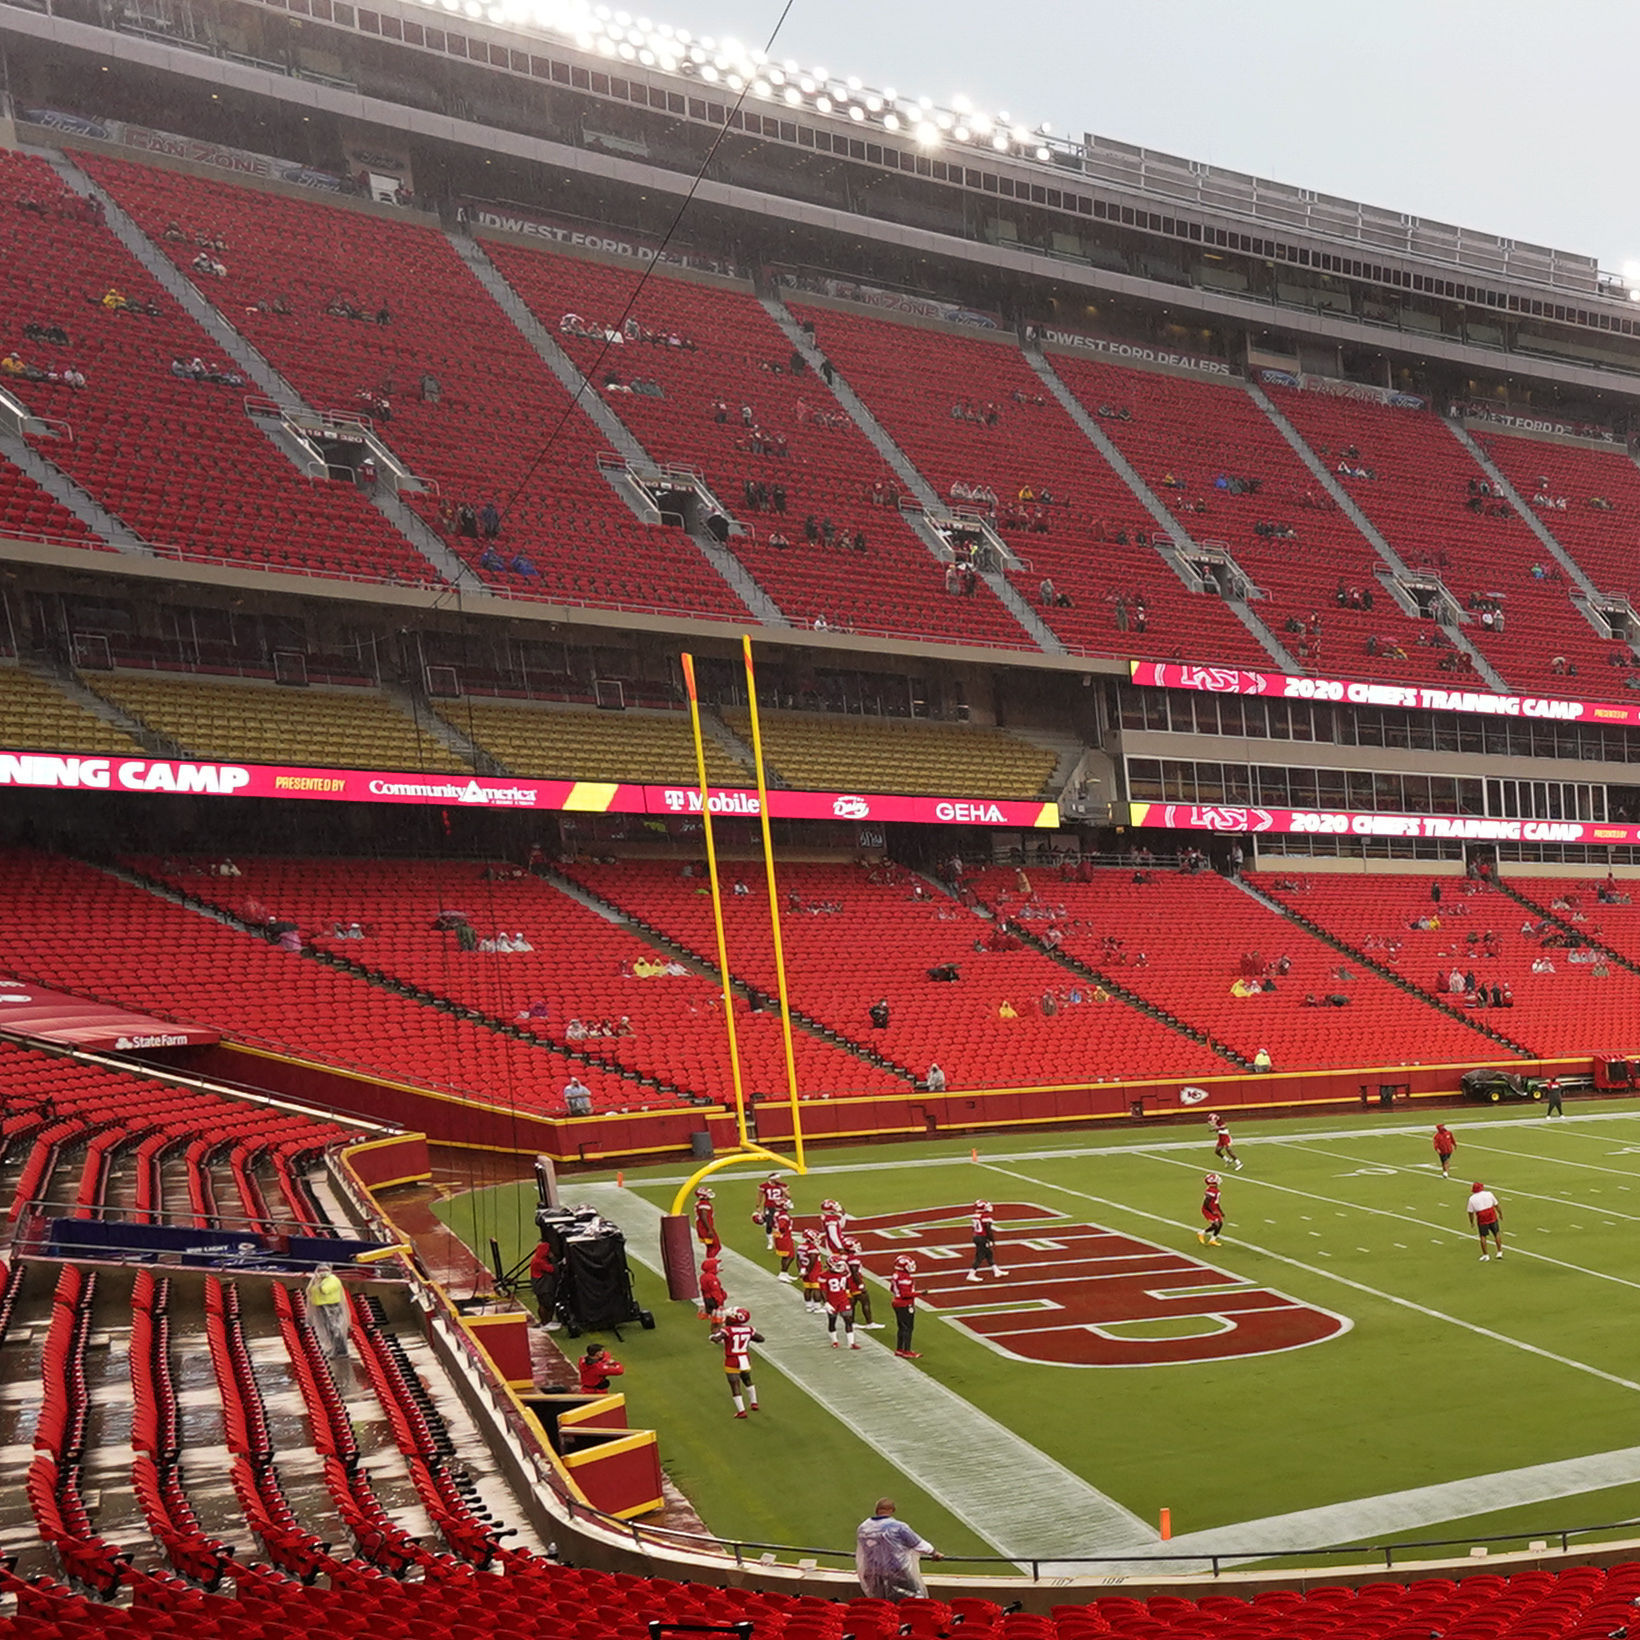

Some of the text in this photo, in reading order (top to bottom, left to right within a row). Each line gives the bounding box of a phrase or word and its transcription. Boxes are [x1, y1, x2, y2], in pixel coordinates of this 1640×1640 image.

[571, 232, 633, 255] FORD
[1110, 343, 1230, 375] FORD DEALERS
[1263, 371, 1298, 386] Ford
[1517, 417, 1551, 433] FORD
[1284, 677, 1583, 720] 2020 CHIEFS TRAINING CAMP
[117, 762, 249, 794] CAMP
[276, 776, 346, 792] PRESENTED BY
[369, 779, 537, 802] CommunityAmerica
[688, 790, 760, 814] Mobile
[936, 802, 1006, 823] GEHA
[1290, 813, 1583, 841] 2020 CHIEFS TRAINING CAMP
[766, 1188, 782, 1200] 12
[828, 1276, 847, 1291] 84
[732, 1334, 750, 1353] 17
